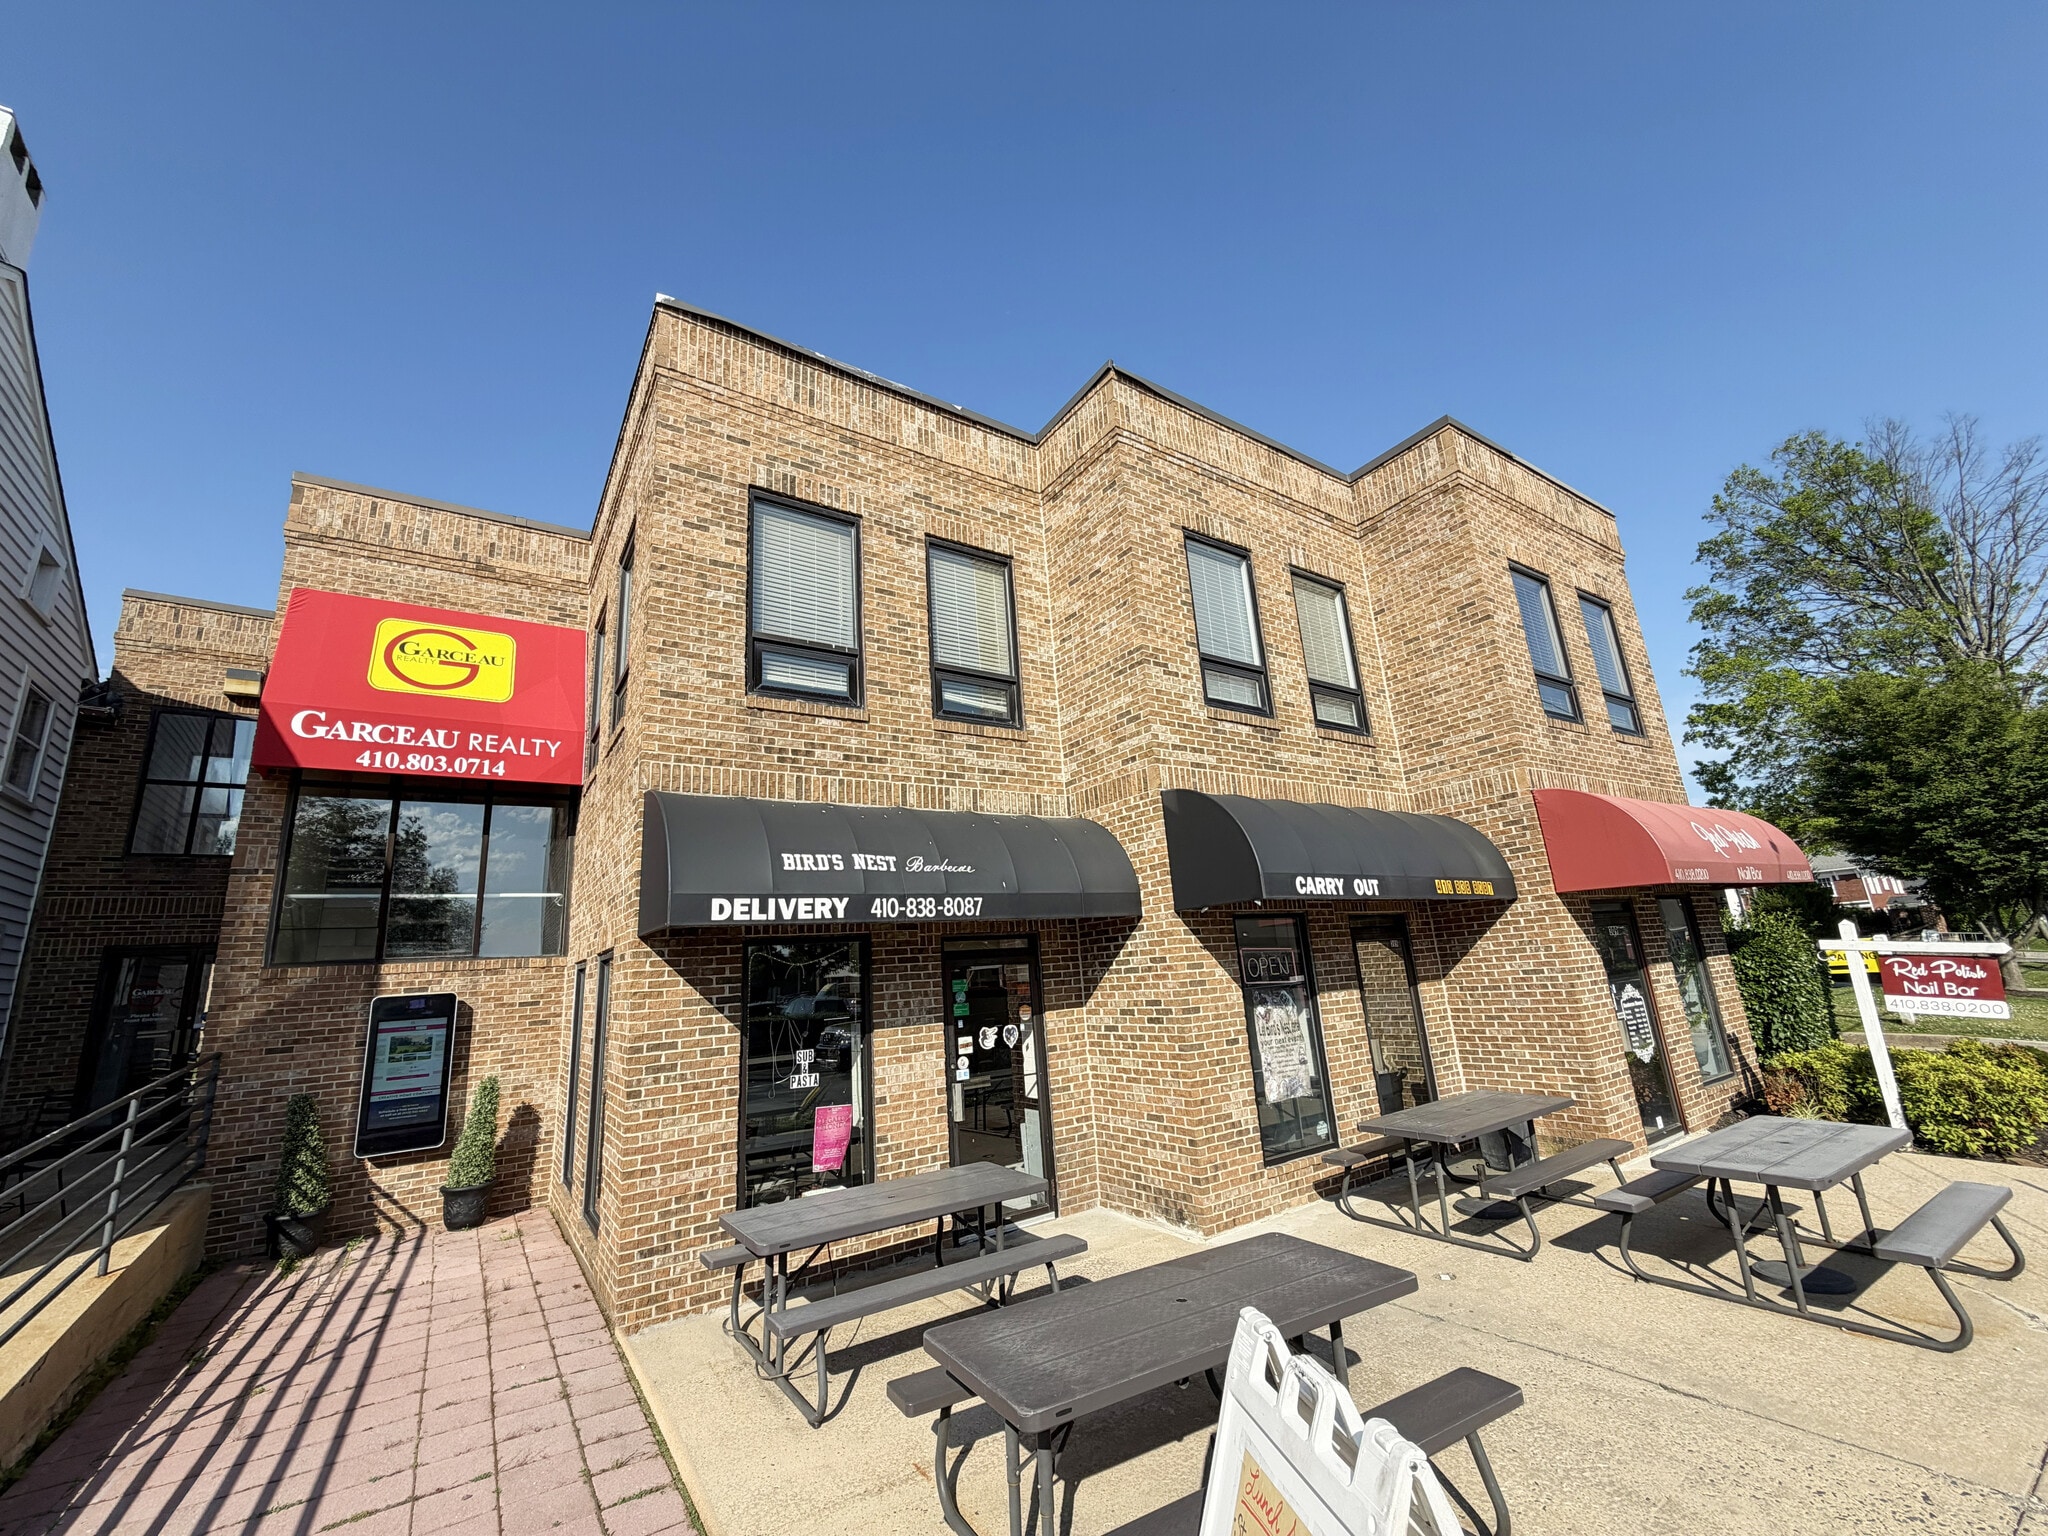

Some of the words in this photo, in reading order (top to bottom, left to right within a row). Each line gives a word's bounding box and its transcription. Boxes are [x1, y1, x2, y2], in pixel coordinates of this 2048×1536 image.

[397, 655, 436, 665] REALTY
[399, 641, 505, 667] GARCEAU
[290, 710, 460, 749] GARCEAU
[469, 734, 561, 758] REALTY
[356, 751, 505, 777] 410.803.0714
[781, 853, 844, 872] BIRD'S
[852, 853, 897, 872] NEST
[905, 855, 976, 873] Barbecue
[1737, 866, 1751, 880] Nail
[1751, 867, 1763, 880] Bar
[1295, 876, 1344, 895] CARRY
[1353, 878, 1380, 896] OUT
[711, 897, 849, 922] DELIVERY
[871, 897, 983, 918] 410-838-8087
[1247, 956, 1290, 978] OPEN
[1885, 957, 1928, 979] Red
[1930, 960, 1987, 979] Polish
[1903, 981, 1939, 995] Nail
[1945, 982, 1979, 997] Bar
[1890, 998, 2004, 1015] 410.838.0200
[797, 1050, 814, 1063] SUB
[802, 1063, 808, 1074] &
[790, 1073, 819, 1088] PASTA
[1245, 1468, 1283, 1534] Lunch
